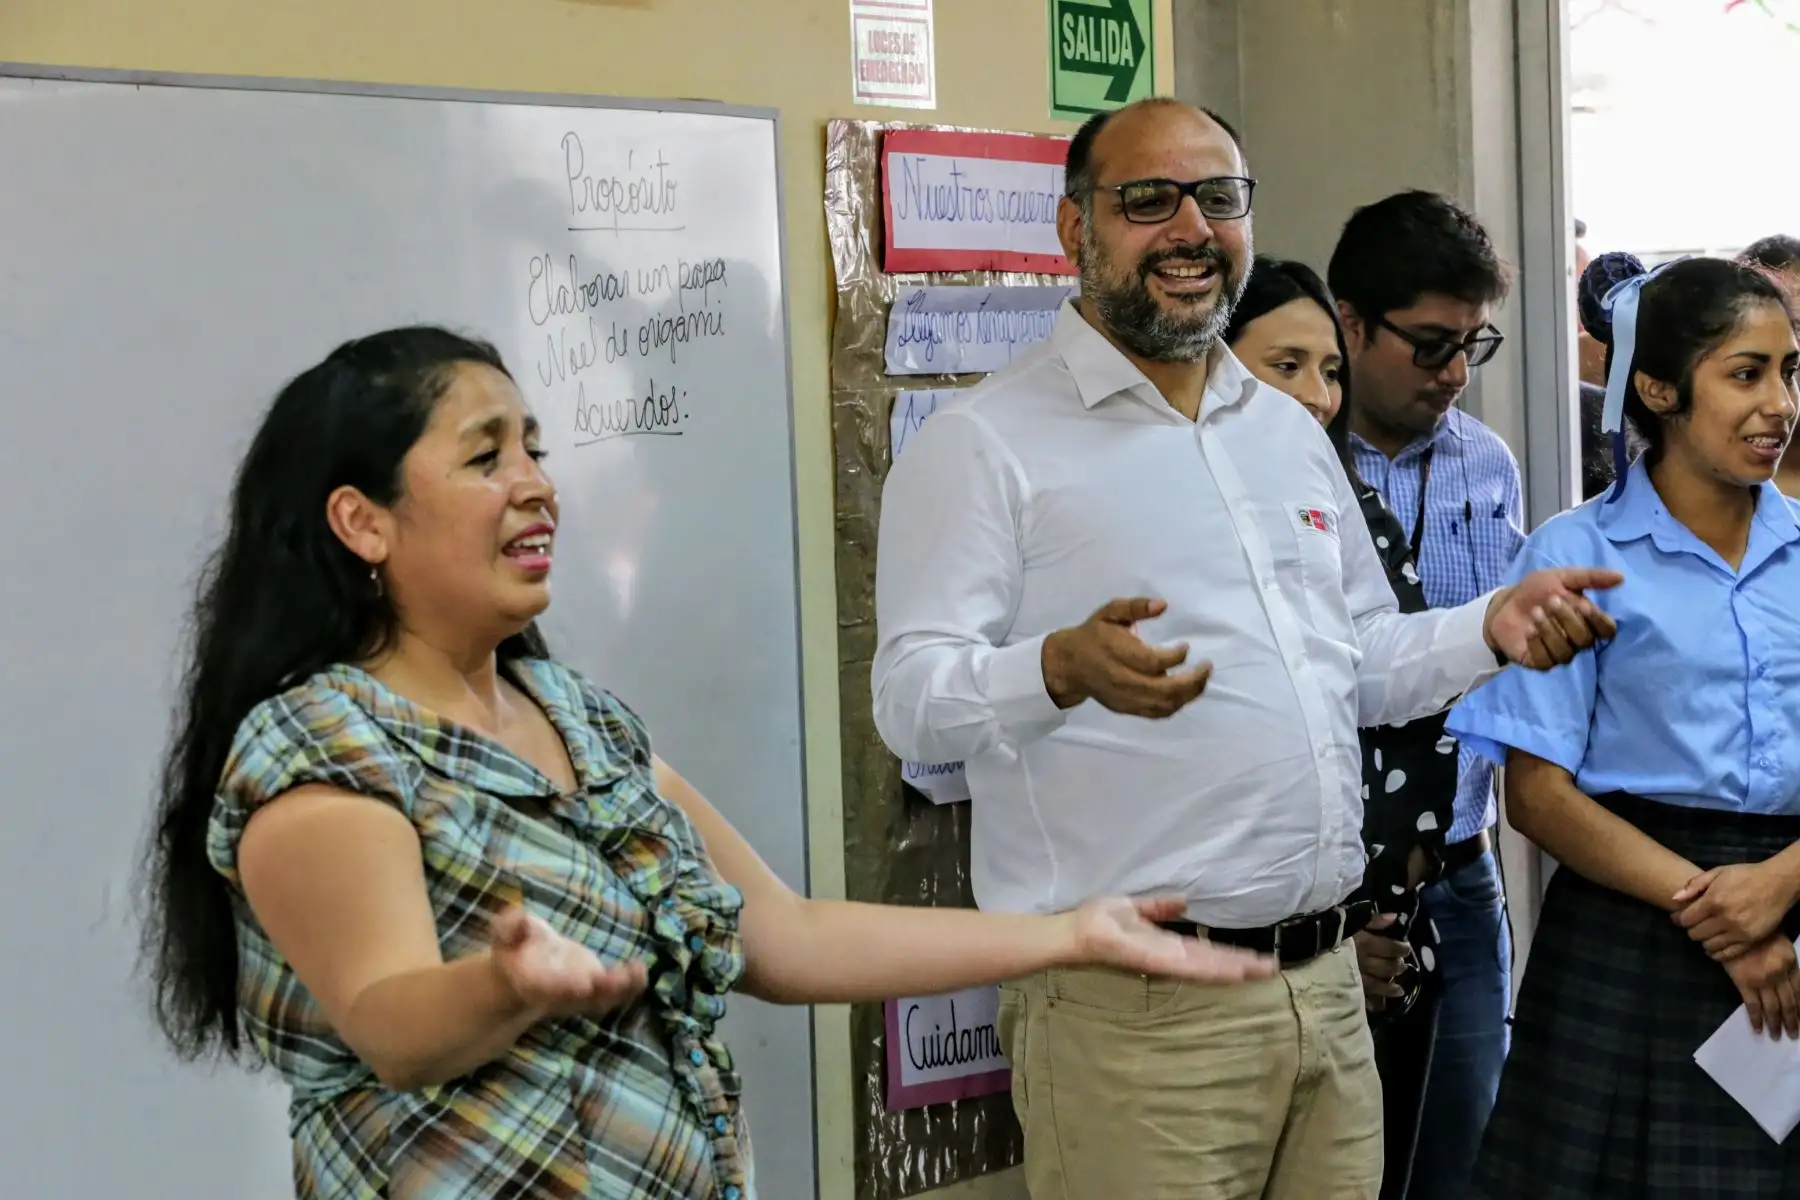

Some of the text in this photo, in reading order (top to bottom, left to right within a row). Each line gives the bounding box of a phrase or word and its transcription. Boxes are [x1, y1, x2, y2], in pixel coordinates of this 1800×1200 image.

[1061, 11, 1135, 68] SALIDA
[560, 130, 679, 238] Propósito
[897, 155, 1066, 225] Nuestros acuerd
[637, 263, 672, 295] un
[605, 320, 629, 364] de
[573, 378, 690, 433] Acuerdos:
[906, 998, 1003, 1071] Cuidam
